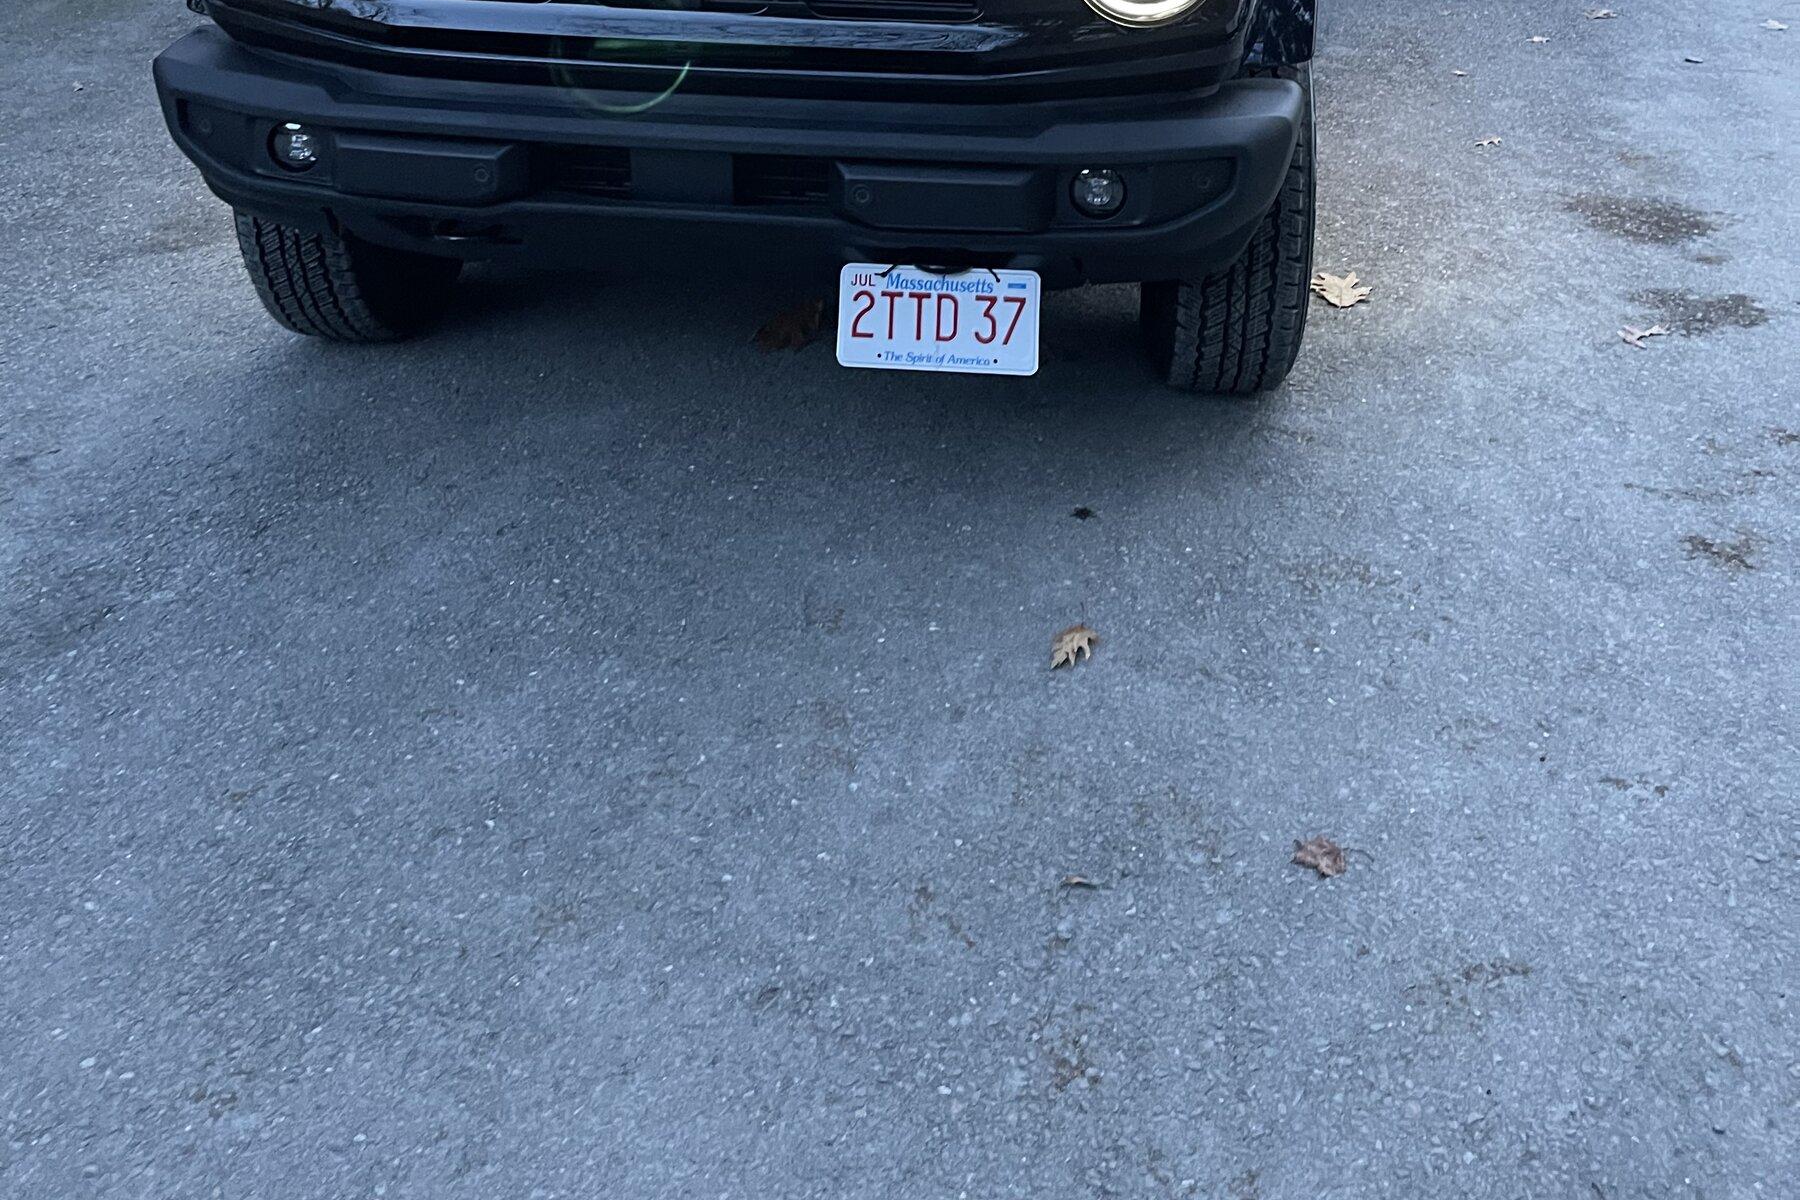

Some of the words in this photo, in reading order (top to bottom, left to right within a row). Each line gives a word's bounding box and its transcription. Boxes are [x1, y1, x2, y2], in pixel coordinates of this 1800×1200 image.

[851, 274, 875, 286] JUL
[886, 273, 994, 293] Massachusetts
[851, 290, 959, 342] 2TTD
[974, 295, 1027, 345] 37
[884, 351, 903, 361] The
[905, 352, 934, 365] Spirit
[935, 354, 946, 365] of
[949, 354, 991, 366] America
